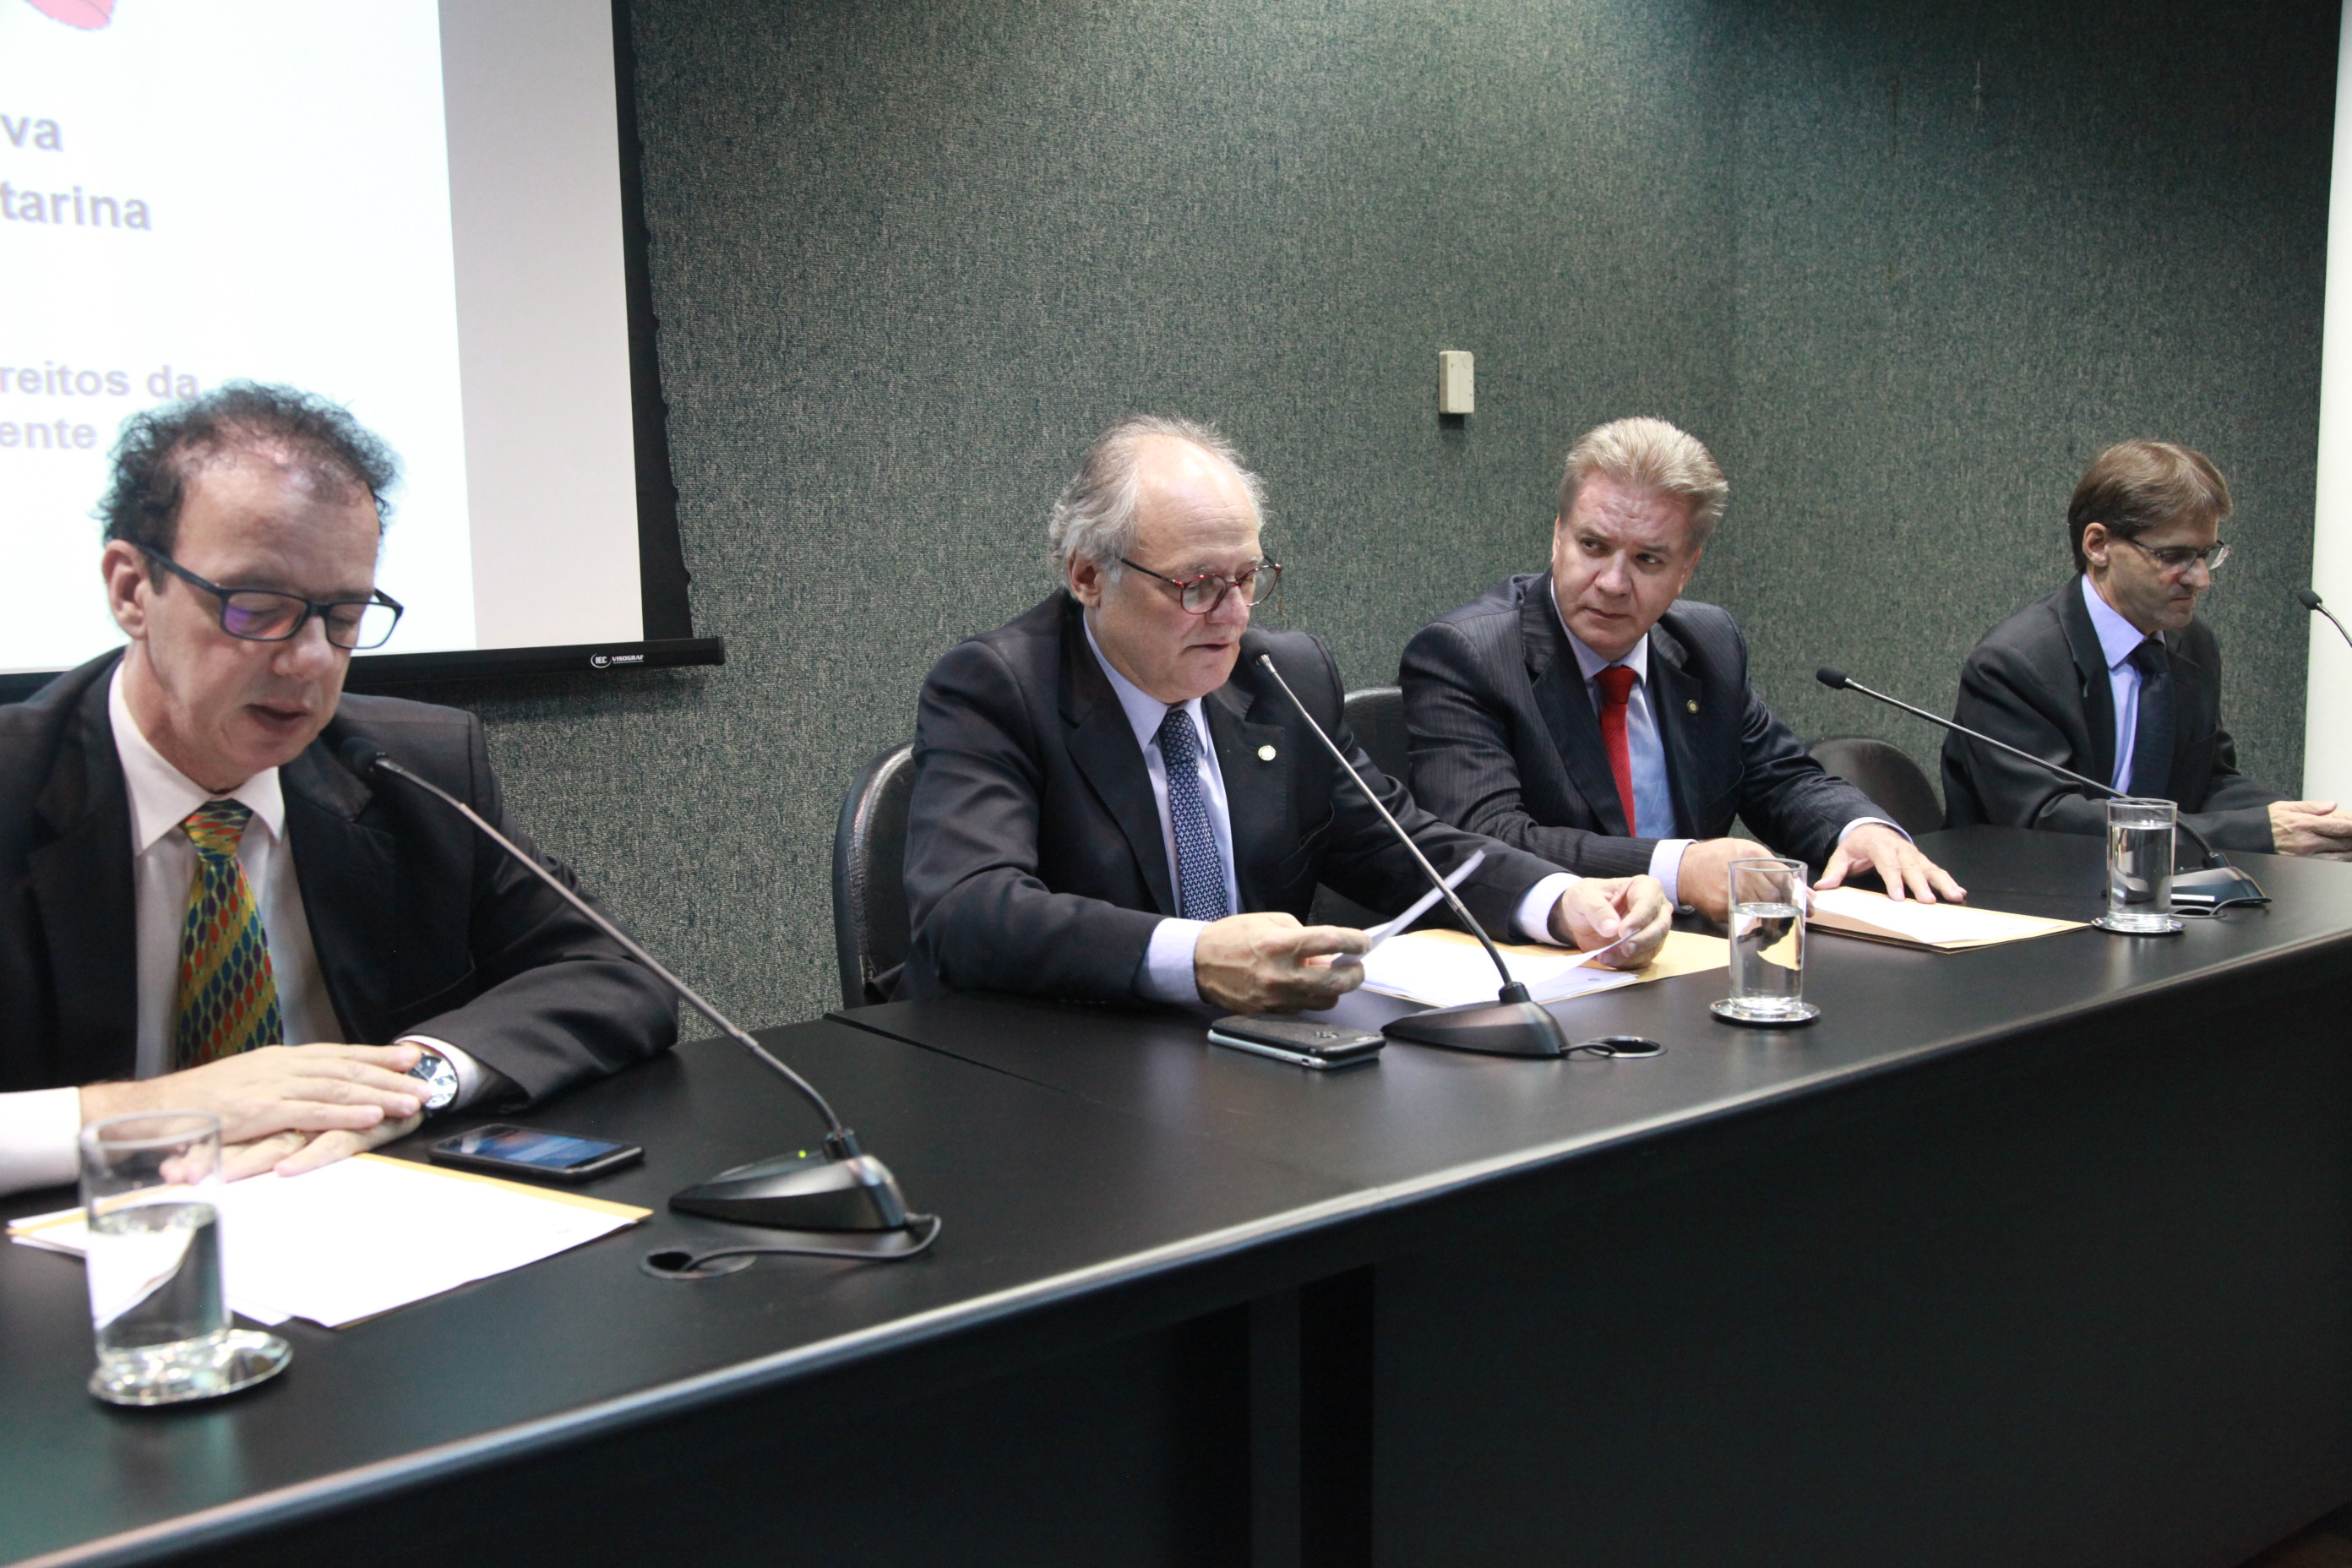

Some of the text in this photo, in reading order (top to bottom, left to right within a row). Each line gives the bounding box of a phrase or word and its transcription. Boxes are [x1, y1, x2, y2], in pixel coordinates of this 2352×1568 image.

[0, 113, 63, 152] va
[0, 181, 152, 231] tarina
[0, 360, 199, 400] reitos da
[0, 418, 98, 449] ente
[612, 654, 645, 662] VISOGRAF
